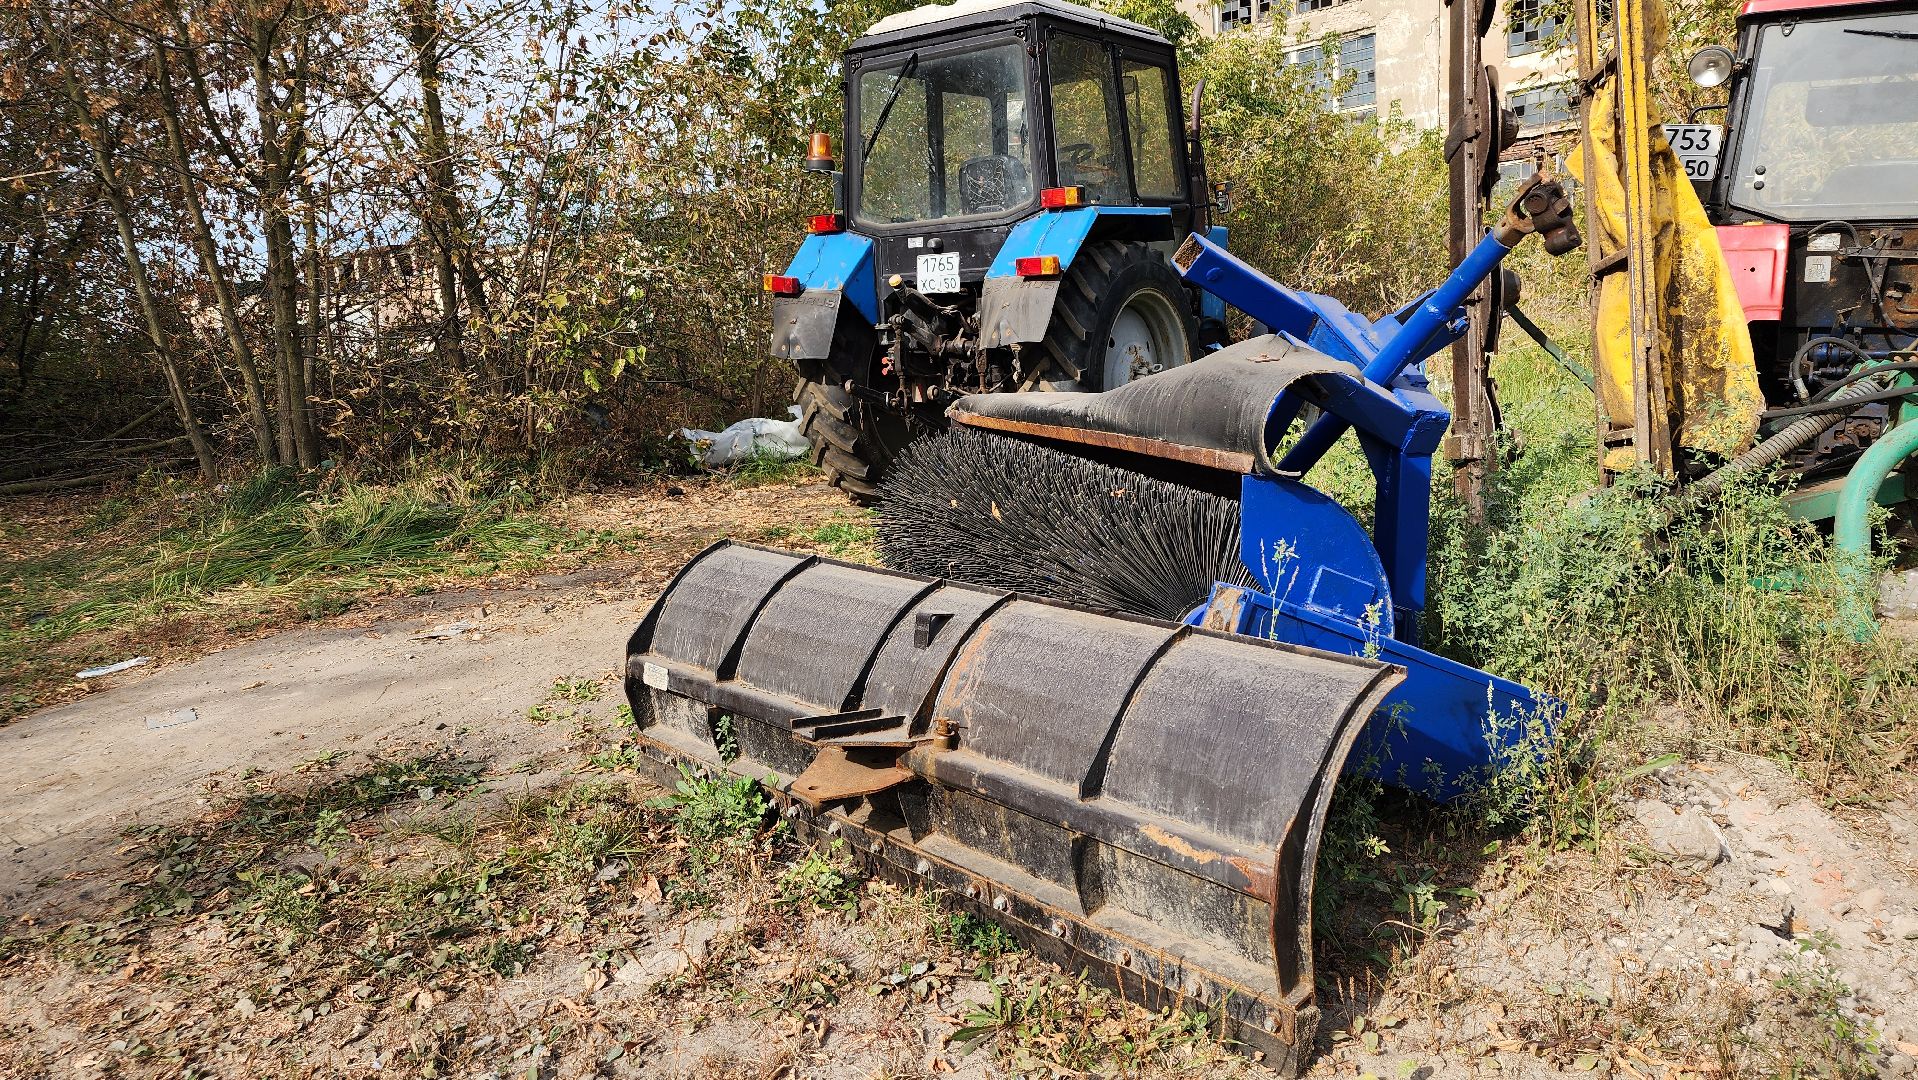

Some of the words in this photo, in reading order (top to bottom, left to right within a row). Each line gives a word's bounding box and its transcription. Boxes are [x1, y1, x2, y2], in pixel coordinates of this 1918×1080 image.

[1685, 159, 1710, 177] 50
[922, 256, 954, 273] 1765
[943, 277, 957, 290] 50
